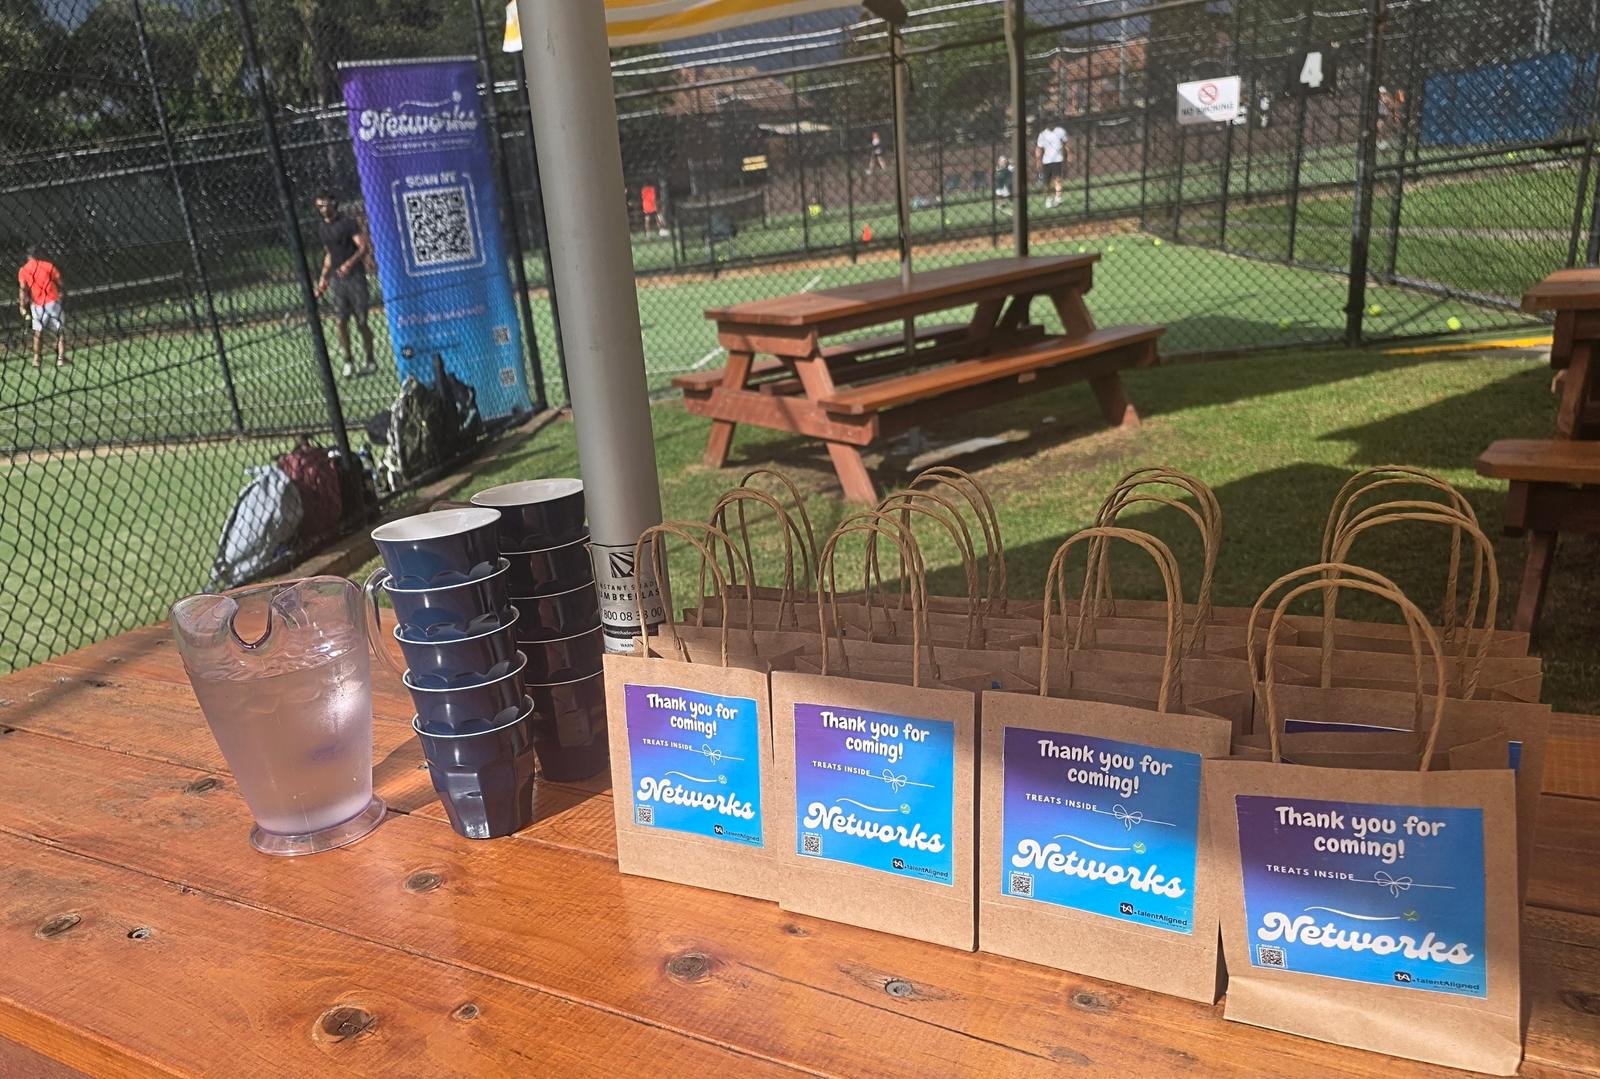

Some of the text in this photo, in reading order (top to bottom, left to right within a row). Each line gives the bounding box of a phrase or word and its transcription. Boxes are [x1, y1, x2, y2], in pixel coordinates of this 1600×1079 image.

[1300, 52, 1323, 88] 4
[631, 580, 658, 591] SAD
[601, 609, 618, 621] 800
[620, 611, 633, 621] 08
[647, 694, 738, 720] Thank you for
[671, 716, 717, 739] coming!
[820, 712, 930, 743] Thank you for
[643, 739, 692, 750] TREATS INSIDE
[846, 737, 903, 763] coming!
[1038, 740, 1173, 776] Thank you for
[813, 761, 870, 776] TREATS INSIDE
[1067, 768, 1139, 798] coming!
[637, 777, 755, 820] Networks
[1026, 793, 1097, 812] TREATS INSIDE
[804, 802, 945, 853] Networks
[1275, 806, 1446, 837] Thank you for
[1314, 836, 1405, 864] coming!
[1012, 839, 1186, 898] Networks
[1266, 865, 1354, 880] TREATS INSIDE
[1257, 912, 1474, 965] Networks
